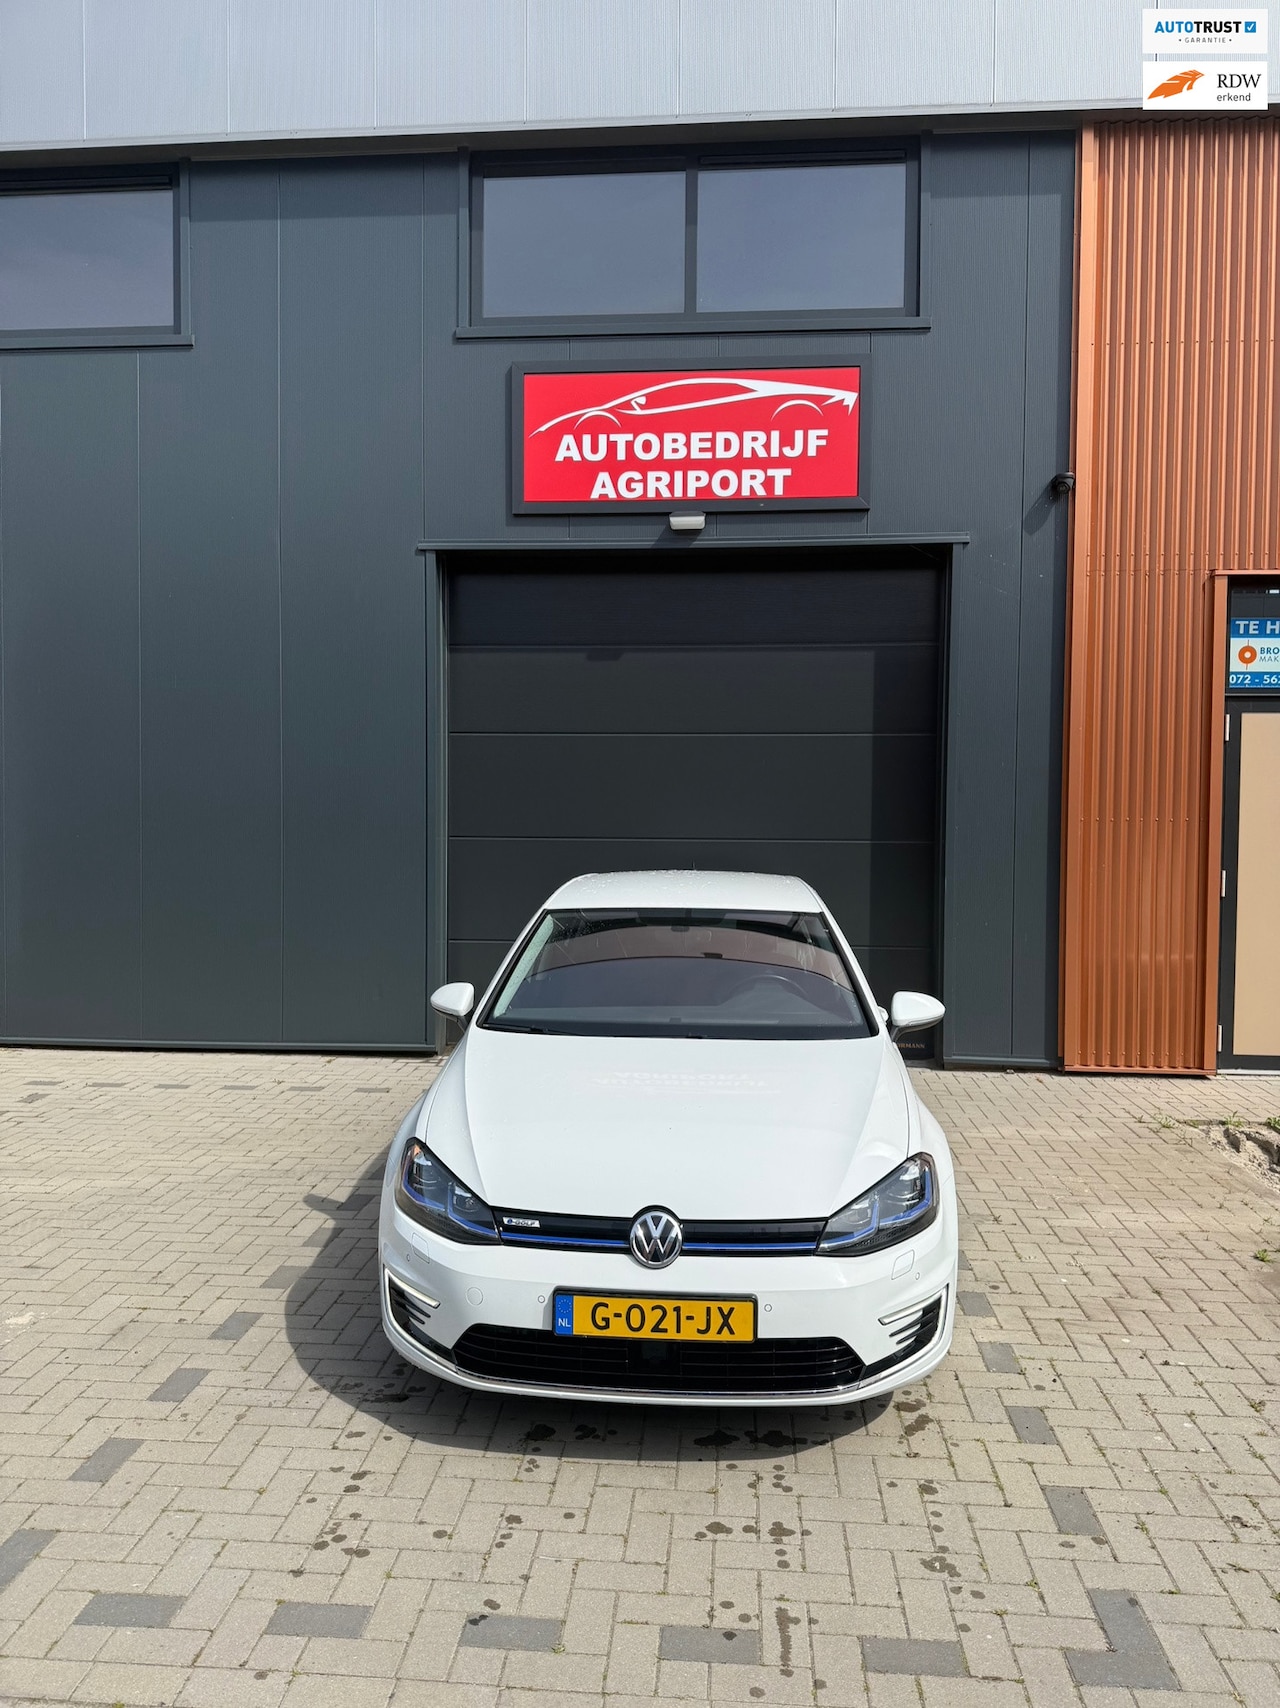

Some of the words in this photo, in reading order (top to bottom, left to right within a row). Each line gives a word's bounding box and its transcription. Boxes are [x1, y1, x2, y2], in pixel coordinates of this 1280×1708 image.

[555, 428, 829, 462] AUTOBEDRIJF
[590, 468, 792, 499] AGRIPORT
[1235, 620, 1260, 635] TE
[1229, 674, 1251, 684] 072
[558, 1317, 572, 1328] NL
[591, 1302, 736, 1335] G-021-JX
